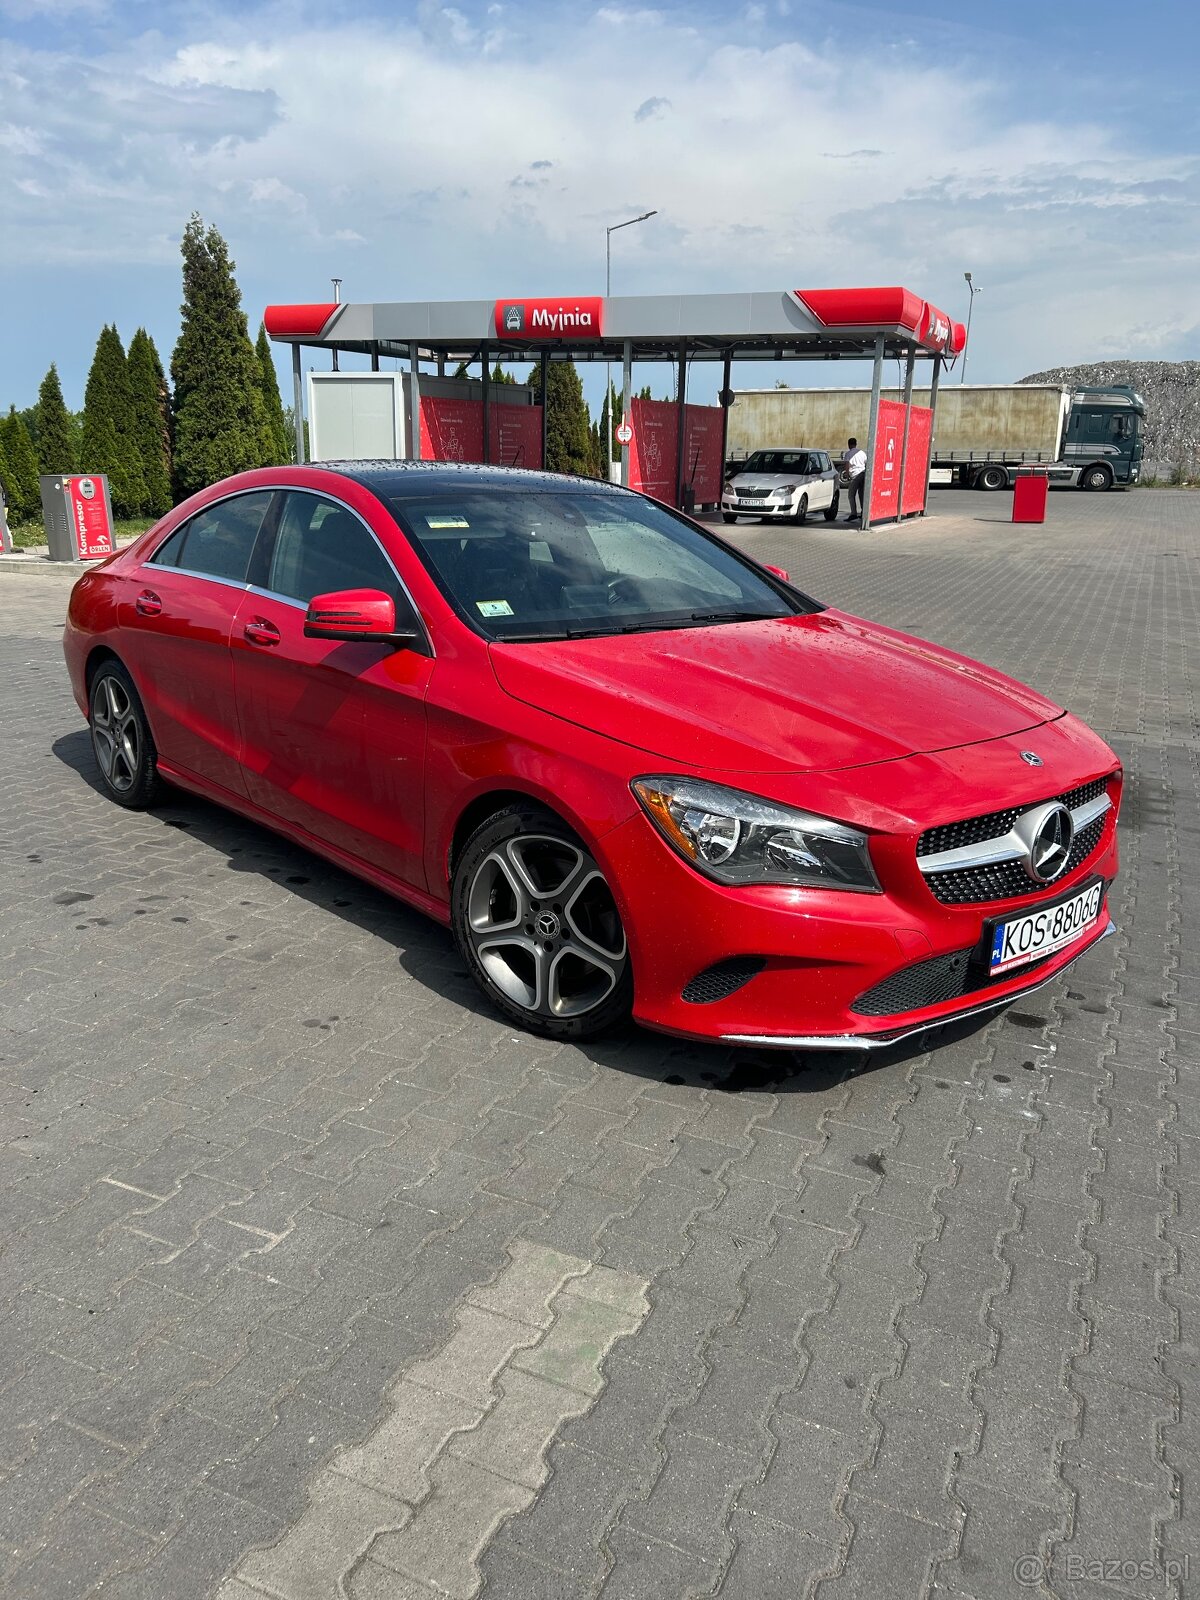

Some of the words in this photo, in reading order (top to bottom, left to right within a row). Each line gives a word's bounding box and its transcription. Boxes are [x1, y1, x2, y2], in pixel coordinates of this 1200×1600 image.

[532, 307, 592, 331] Myjnia
[76, 499, 88, 554] Kompresor
[1003, 914, 1047, 959] KOS
[1052, 886, 1100, 939] 8806G
[992, 948, 1000, 960] PL
